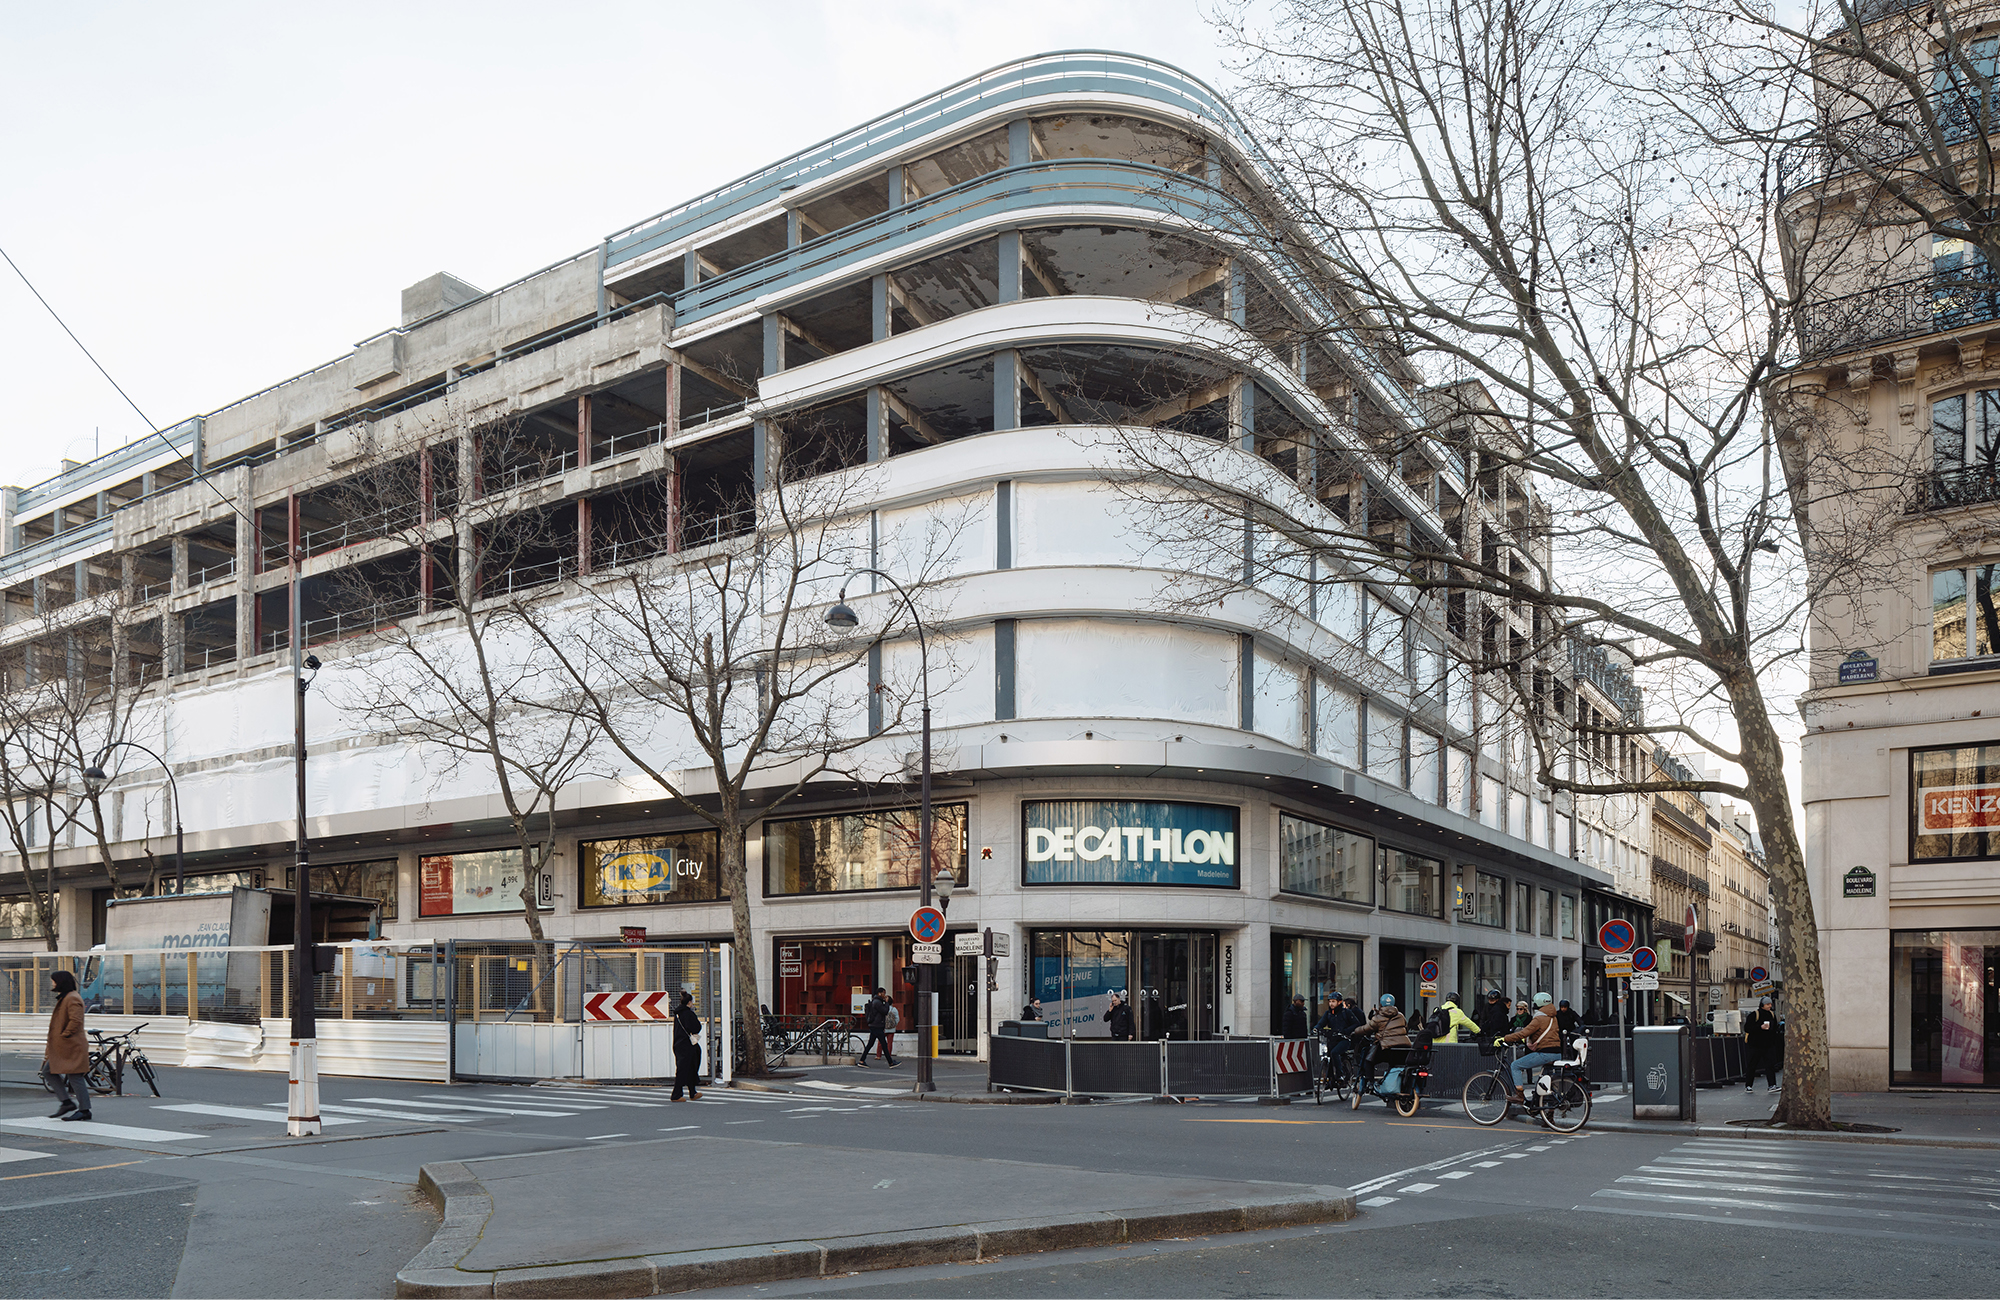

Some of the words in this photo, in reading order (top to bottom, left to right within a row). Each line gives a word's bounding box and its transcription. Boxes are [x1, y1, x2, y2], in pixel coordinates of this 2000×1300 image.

[1842, 661, 1874, 670] BOULEVARD
[1027, 825, 1234, 866] DECATHLON
[608, 861, 666, 881] IKEA
[676, 858, 703, 880] City
[1197, 869, 1230, 879] Madeleine
[197, 923, 211, 932] JEAN
[1044, 970, 1093, 986] BIENVENUE
[1043, 1013, 1095, 1028] DECATHLON
